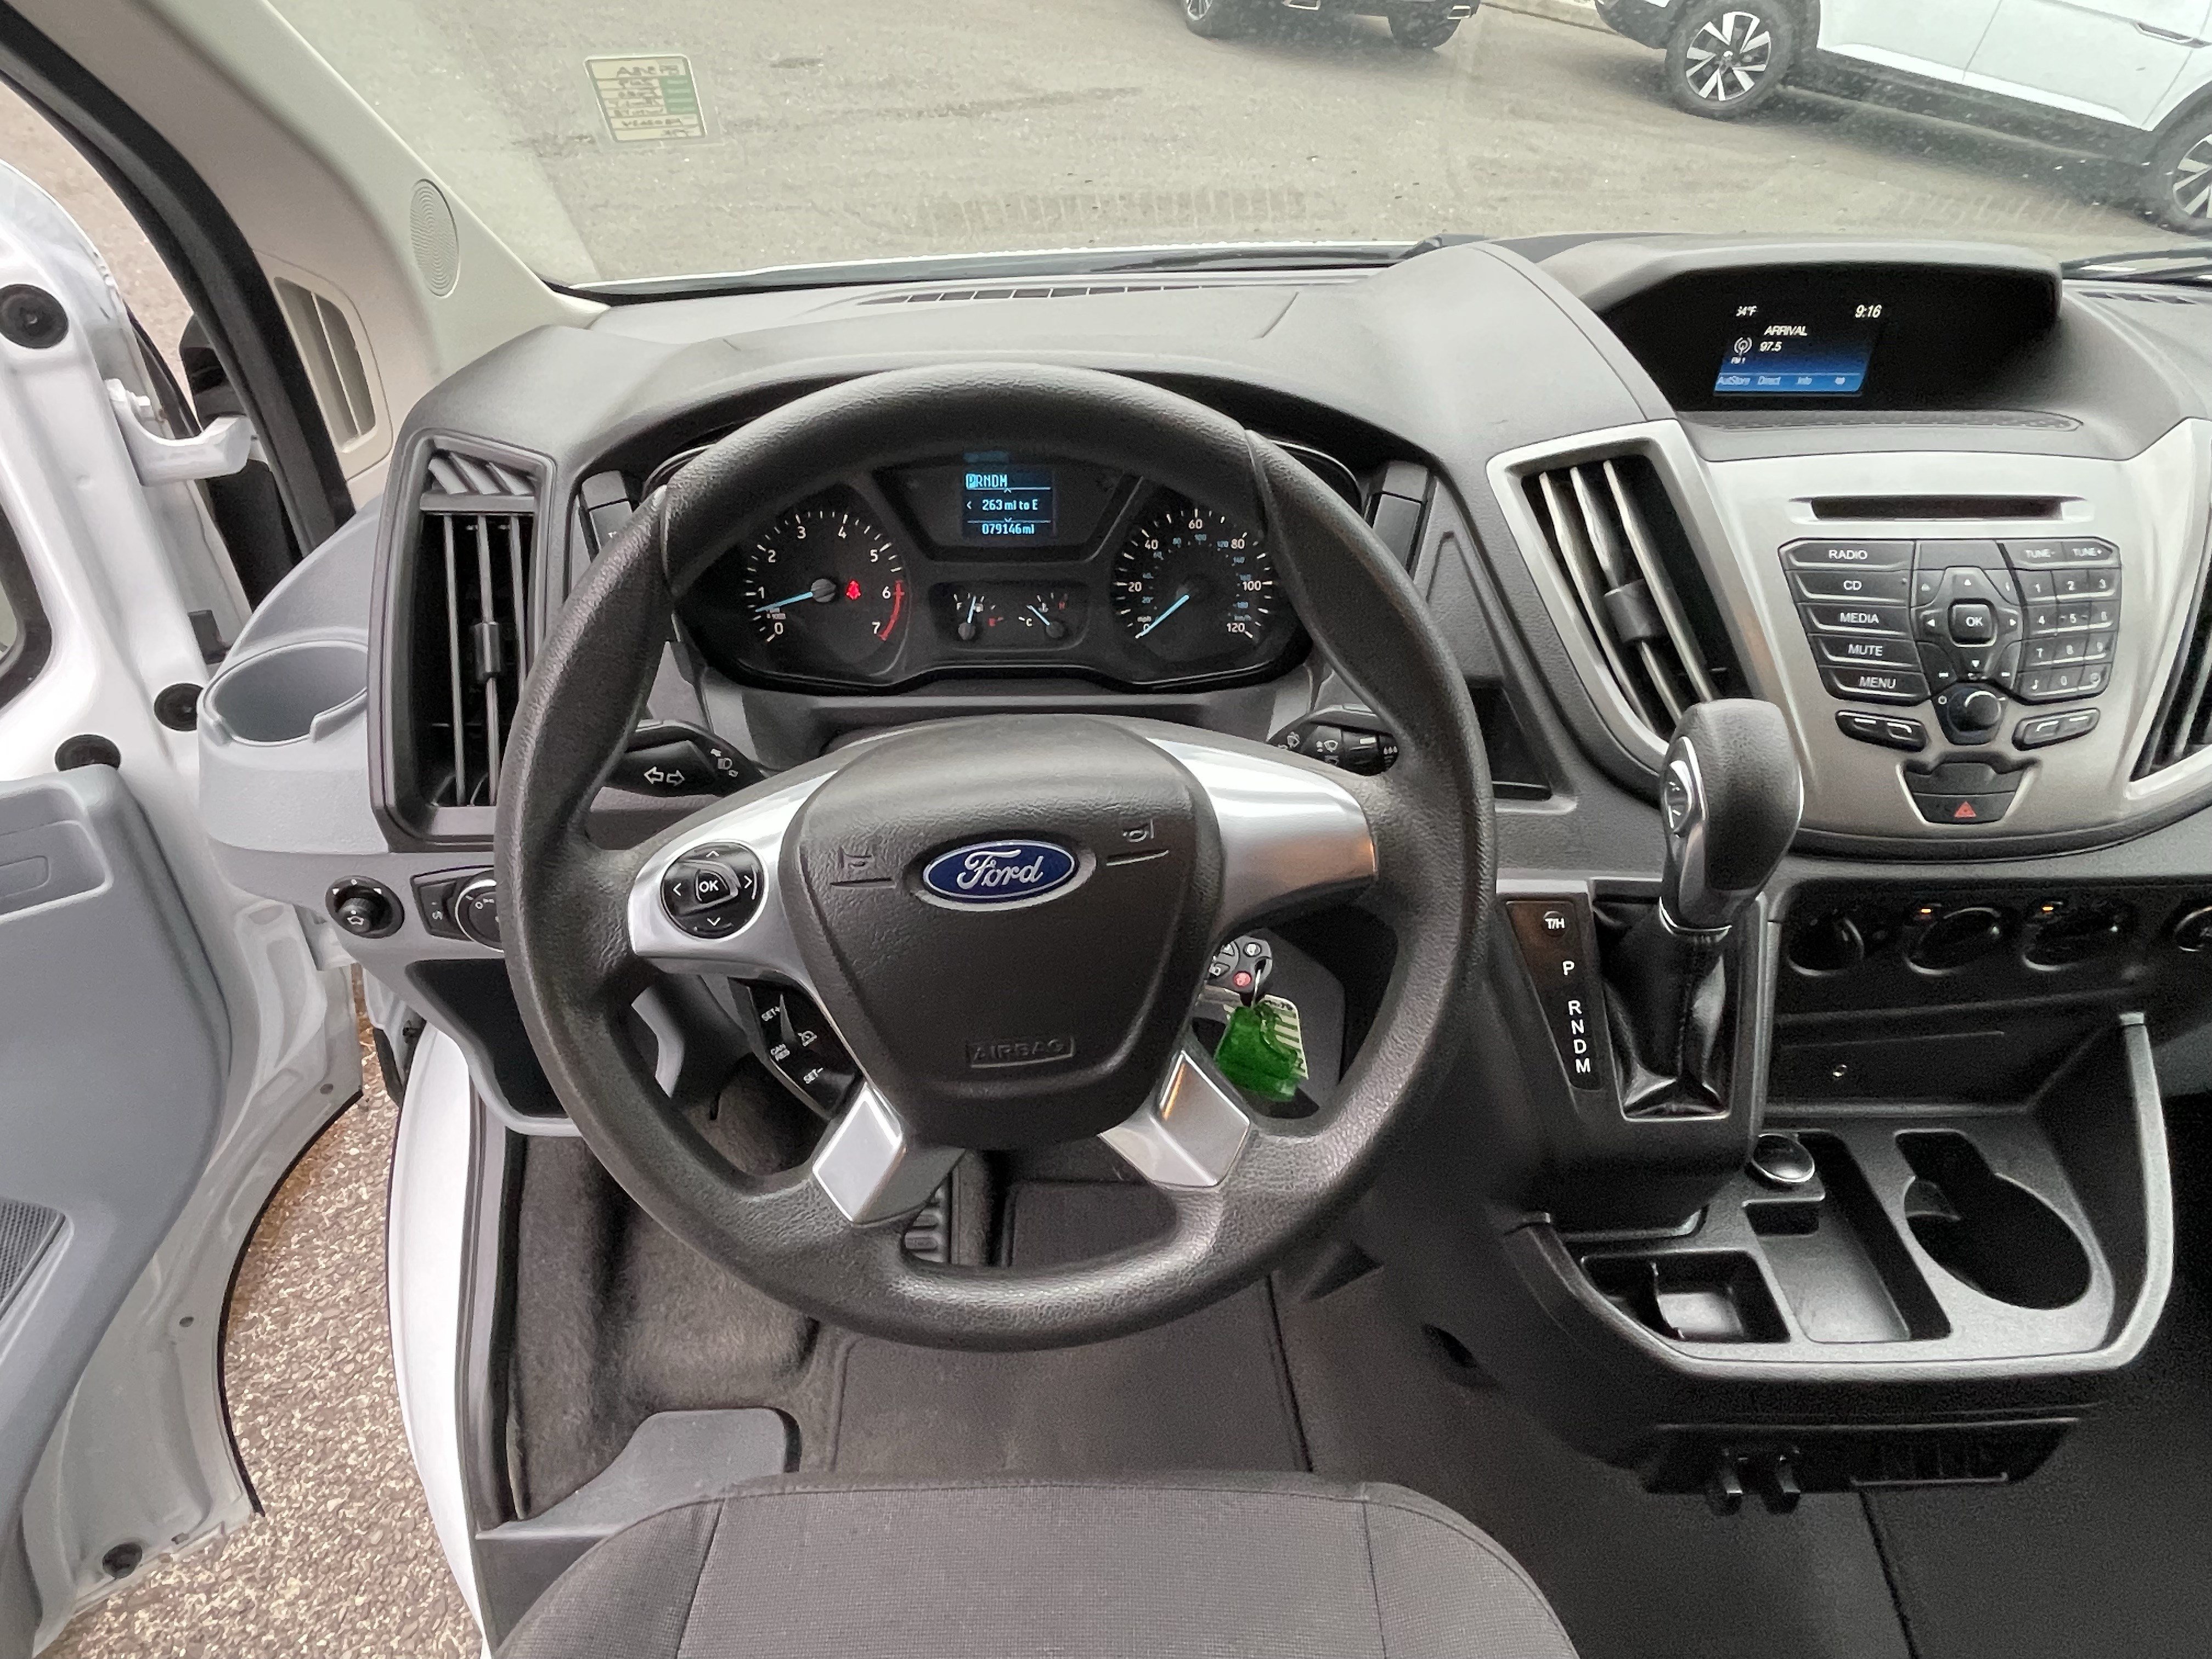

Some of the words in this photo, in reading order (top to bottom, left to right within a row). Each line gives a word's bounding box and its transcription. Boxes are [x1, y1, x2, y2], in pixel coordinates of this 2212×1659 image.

[1854, 304, 1882, 318] 9:16
[1763, 325, 1808, 336] ARRIVAL
[1759, 341, 1782, 352] 97.5
[982, 499, 1003, 510] 263
[1018, 500, 1030, 510] to
[1032, 498, 1039, 510] E
[982, 523, 1022, 535] 079146
[1188, 518, 1203, 529] 60
[798, 526, 806, 539] 3
[838, 526, 847, 539] 4
[1144, 539, 1159, 550] 40
[1231, 539, 1245, 549] 80
[768, 550, 776, 563] 2
[870, 549, 878, 562] 5
[1828, 549, 1868, 560] RADIO
[1128, 582, 1142, 592] 20
[1242, 580, 1262, 591] 100
[1843, 580, 1863, 591] CD
[2034, 583, 2041, 592] 1
[2067, 580, 2075, 590] 2
[2099, 578, 2107, 589] 3
[758, 586, 765, 599] 1
[882, 585, 891, 599] 6
[1839, 612, 1880, 624] MEDIA
[1965, 616, 1984, 627] OK
[2038, 615, 2045, 625] 4
[2069, 613, 2077, 623] 5
[774, 622, 783, 635] 0
[871, 621, 881, 634] 7
[1227, 622, 1245, 633] 120
[1848, 644, 1883, 657] MUTE
[2036, 647, 2044, 658] 7
[1859, 676, 1897, 690] MENU
[2060, 675, 2068, 686] 0
[956, 849, 1043, 890] Ford
[698, 880, 719, 893] OK
[1544, 918, 1565, 929] T/H
[1562, 960, 1575, 976] P
[1568, 1000, 1582, 1015] R
[1571, 1020, 1585, 1034] N
[1573, 1039, 1587, 1054] D
[1575, 1058, 1591, 1073] M
